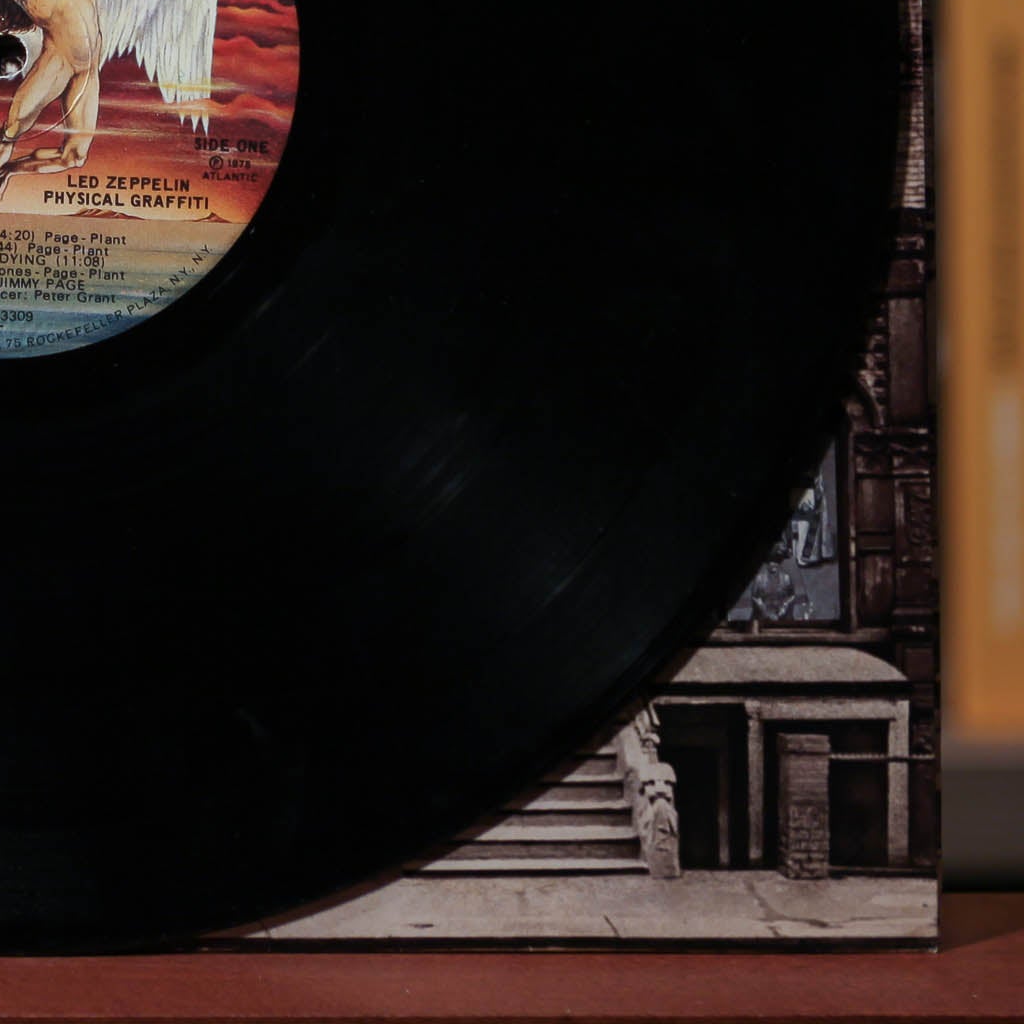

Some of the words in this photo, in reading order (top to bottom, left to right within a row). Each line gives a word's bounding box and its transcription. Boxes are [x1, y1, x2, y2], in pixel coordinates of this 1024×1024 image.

[194, 137, 230, 152] SIDE
[237, 139, 269, 154] ONE
[66, 174, 100, 189] LED
[106, 176, 190, 192] ZEPPELIN
[202, 171, 259, 183] ATLANTIC
[43, 190, 125, 207] PHYSICAL
[130, 194, 209, 209] GRAFFITI
[0, 253, 46, 266] DYING
[56, 256, 105, 269] (11:08)
[46, 278, 86, 291] PAGE
[34, 289, 70, 302] Peter
[76, 291, 116, 303] Grant
[5, 337, 22, 349] 75
[26, 309, 124, 348] ROCKEFELLER
